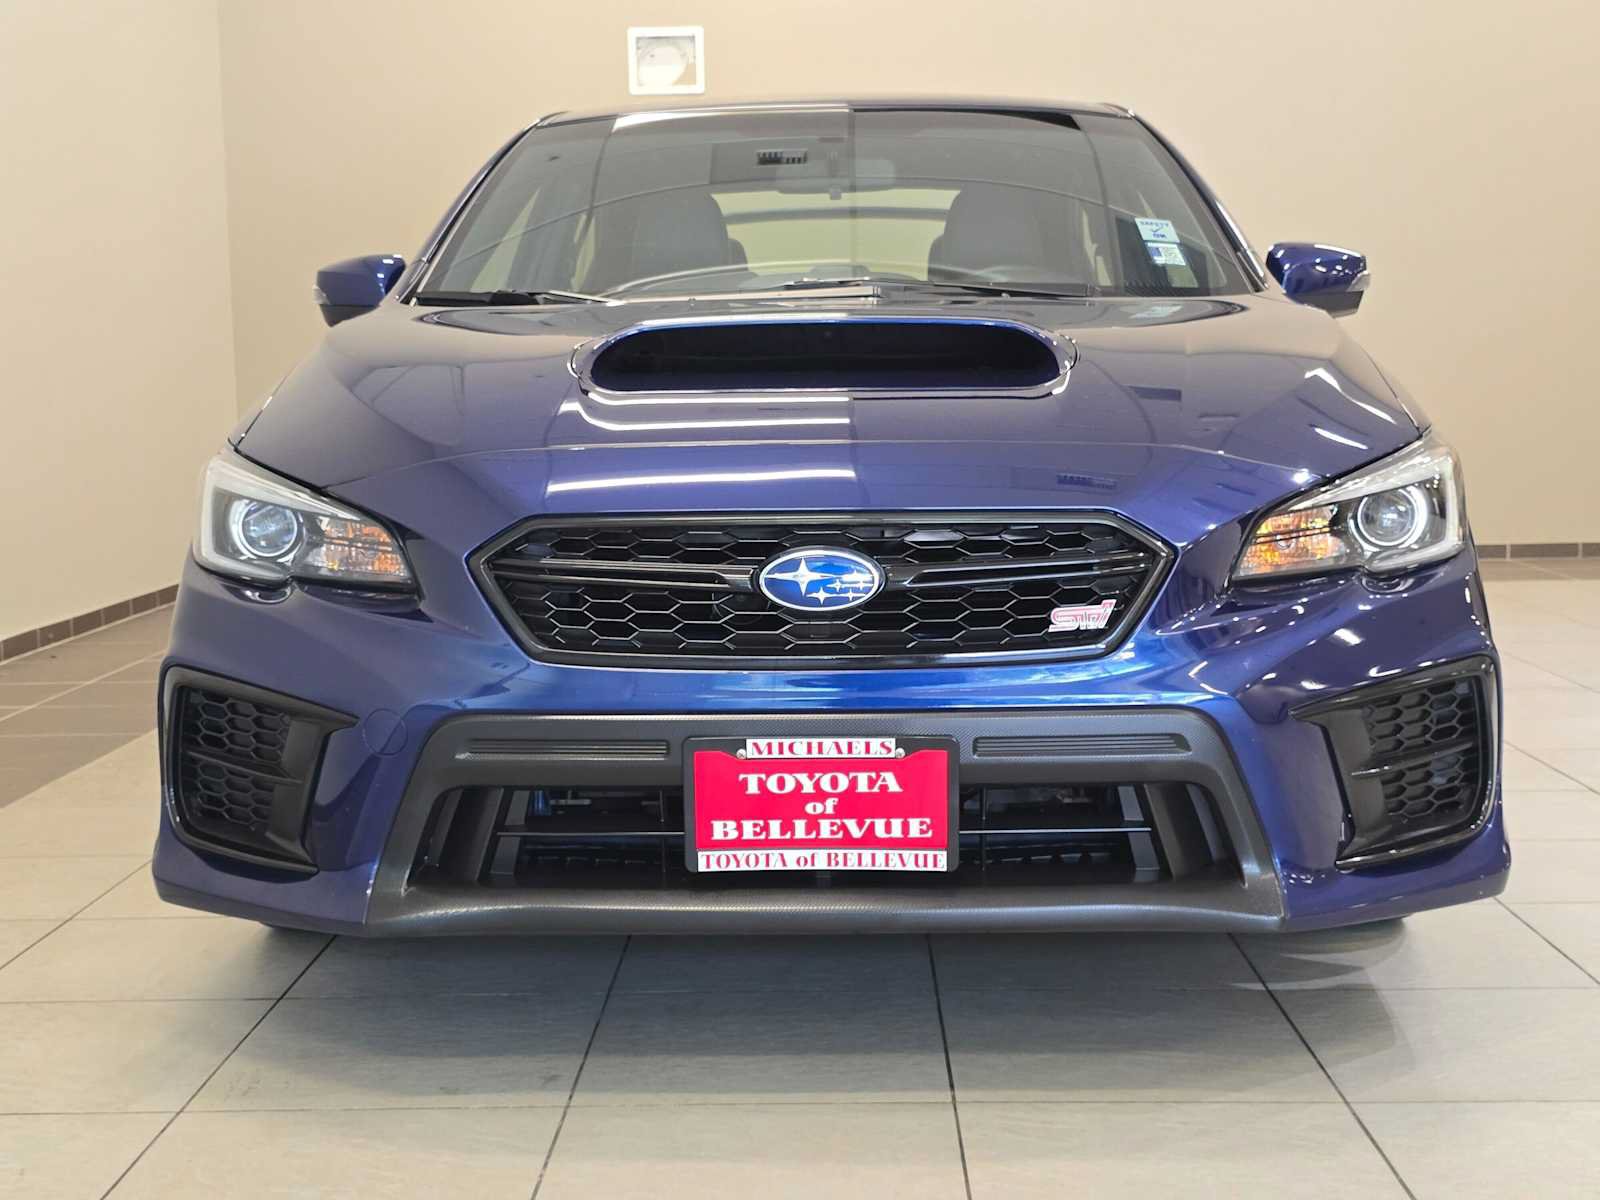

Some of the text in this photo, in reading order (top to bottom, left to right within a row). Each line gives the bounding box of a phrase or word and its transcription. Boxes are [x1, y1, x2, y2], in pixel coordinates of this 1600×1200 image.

[751, 739, 893, 756] MICHAELS
[738, 771, 903, 794] TOYOTA
[804, 797, 839, 815] of
[710, 817, 933, 841] BELLEVUE
[701, 852, 945, 869] TOYOTA of BELLEVUE
